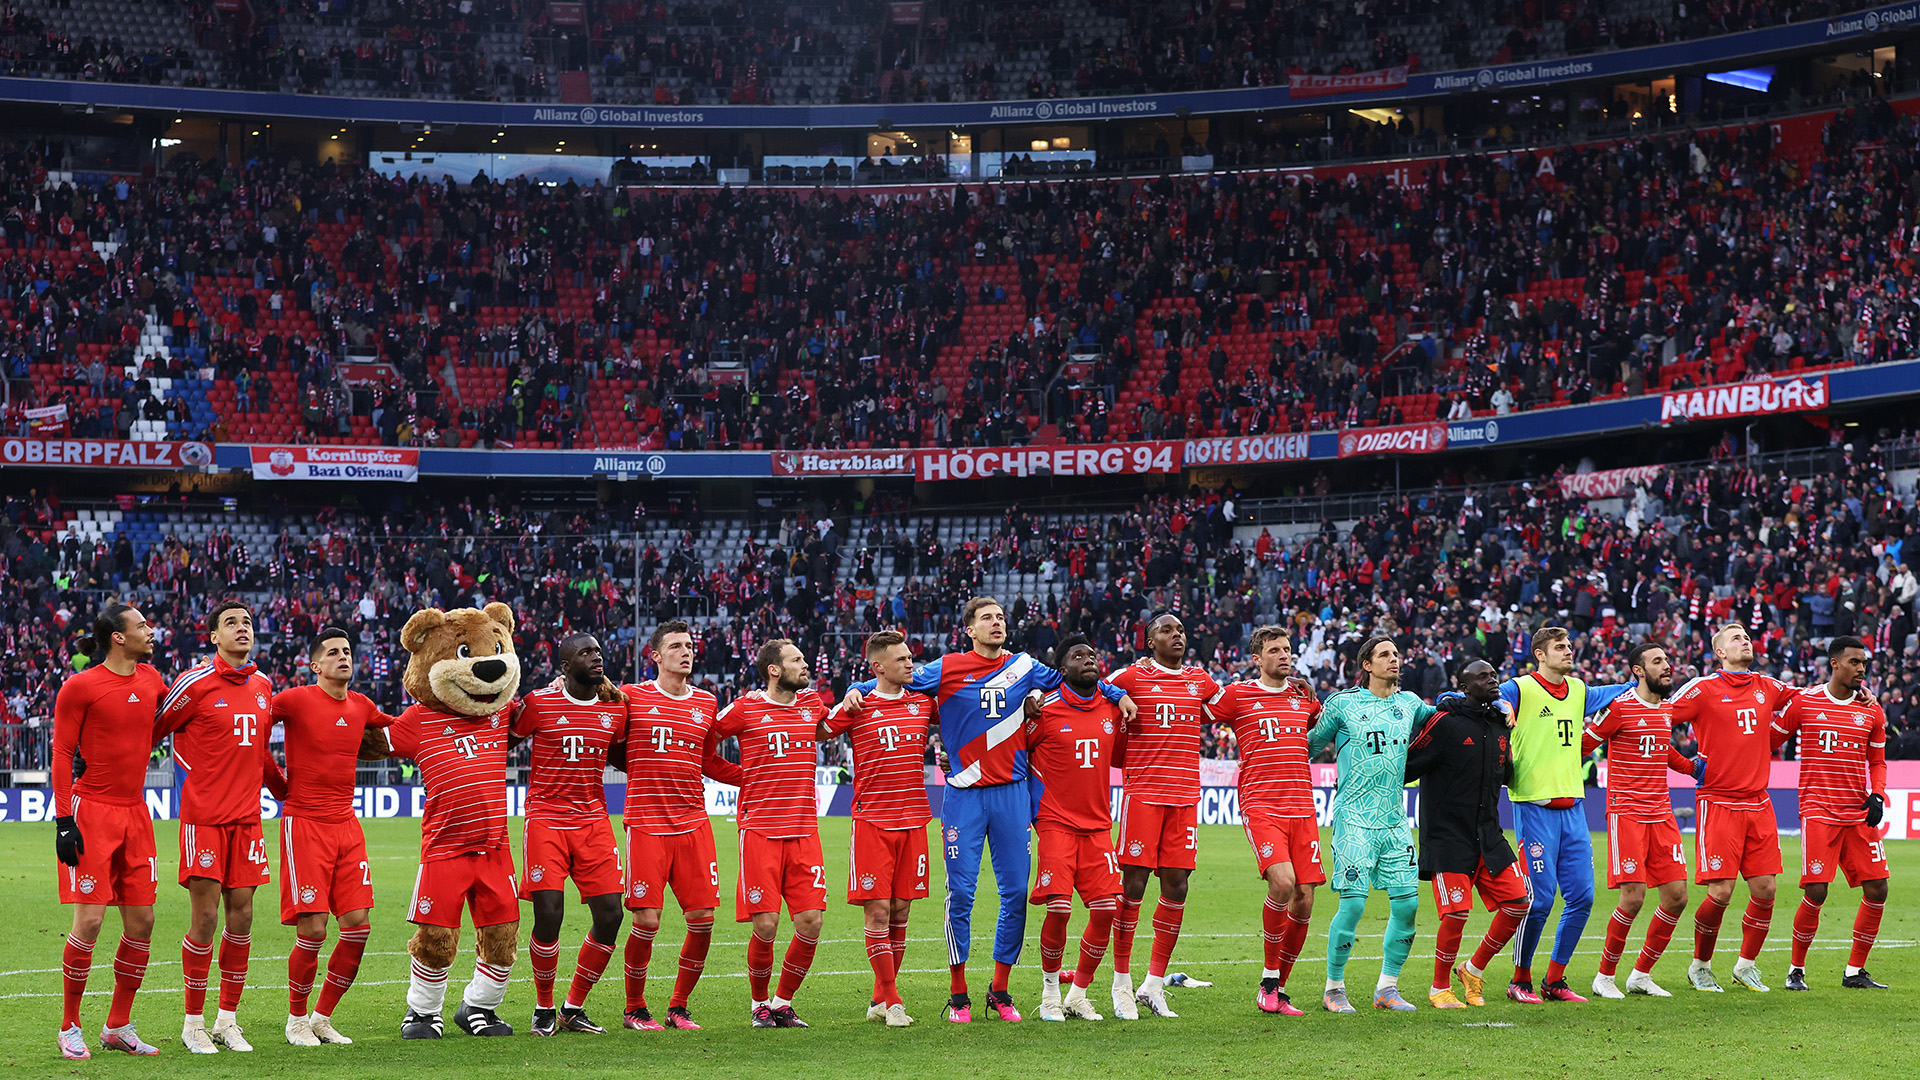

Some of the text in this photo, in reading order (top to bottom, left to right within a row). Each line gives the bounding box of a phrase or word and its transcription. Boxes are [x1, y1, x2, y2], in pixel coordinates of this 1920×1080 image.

[1826, 6, 1917, 36] Allianz Global
[1434, 62, 1593, 89] Allianz Global Investors
[533, 109, 704, 122] Allianz Global Investors
[990, 100, 1157, 118] Allianz Global Investors
[1662, 379, 1824, 420] MAINBURG
[1448, 427, 1485, 442] Allianz
[3, 439, 172, 465] OBERPFALZ
[306, 447, 402, 464] Kornlupfer
[1184, 434, 1309, 463] ROTE SOCKEN
[308, 465, 403, 478] Bazi Offenau
[593, 457, 644, 471] Allianz
[802, 453, 905, 472] Herzbladl
[980, 687, 1006, 719] T
[233, 714, 257, 746] T
[1557, 719, 1573, 746] T
[1736, 708, 1757, 735] T
[1075, 738, 1099, 769] T
[248, 838, 267, 864] 42
[1310, 840, 1321, 863] 2
[359, 861, 372, 885] 2
[709, 862, 719, 886] 5
[917, 854, 926, 877] 6
[508, 873, 518, 898] 1
